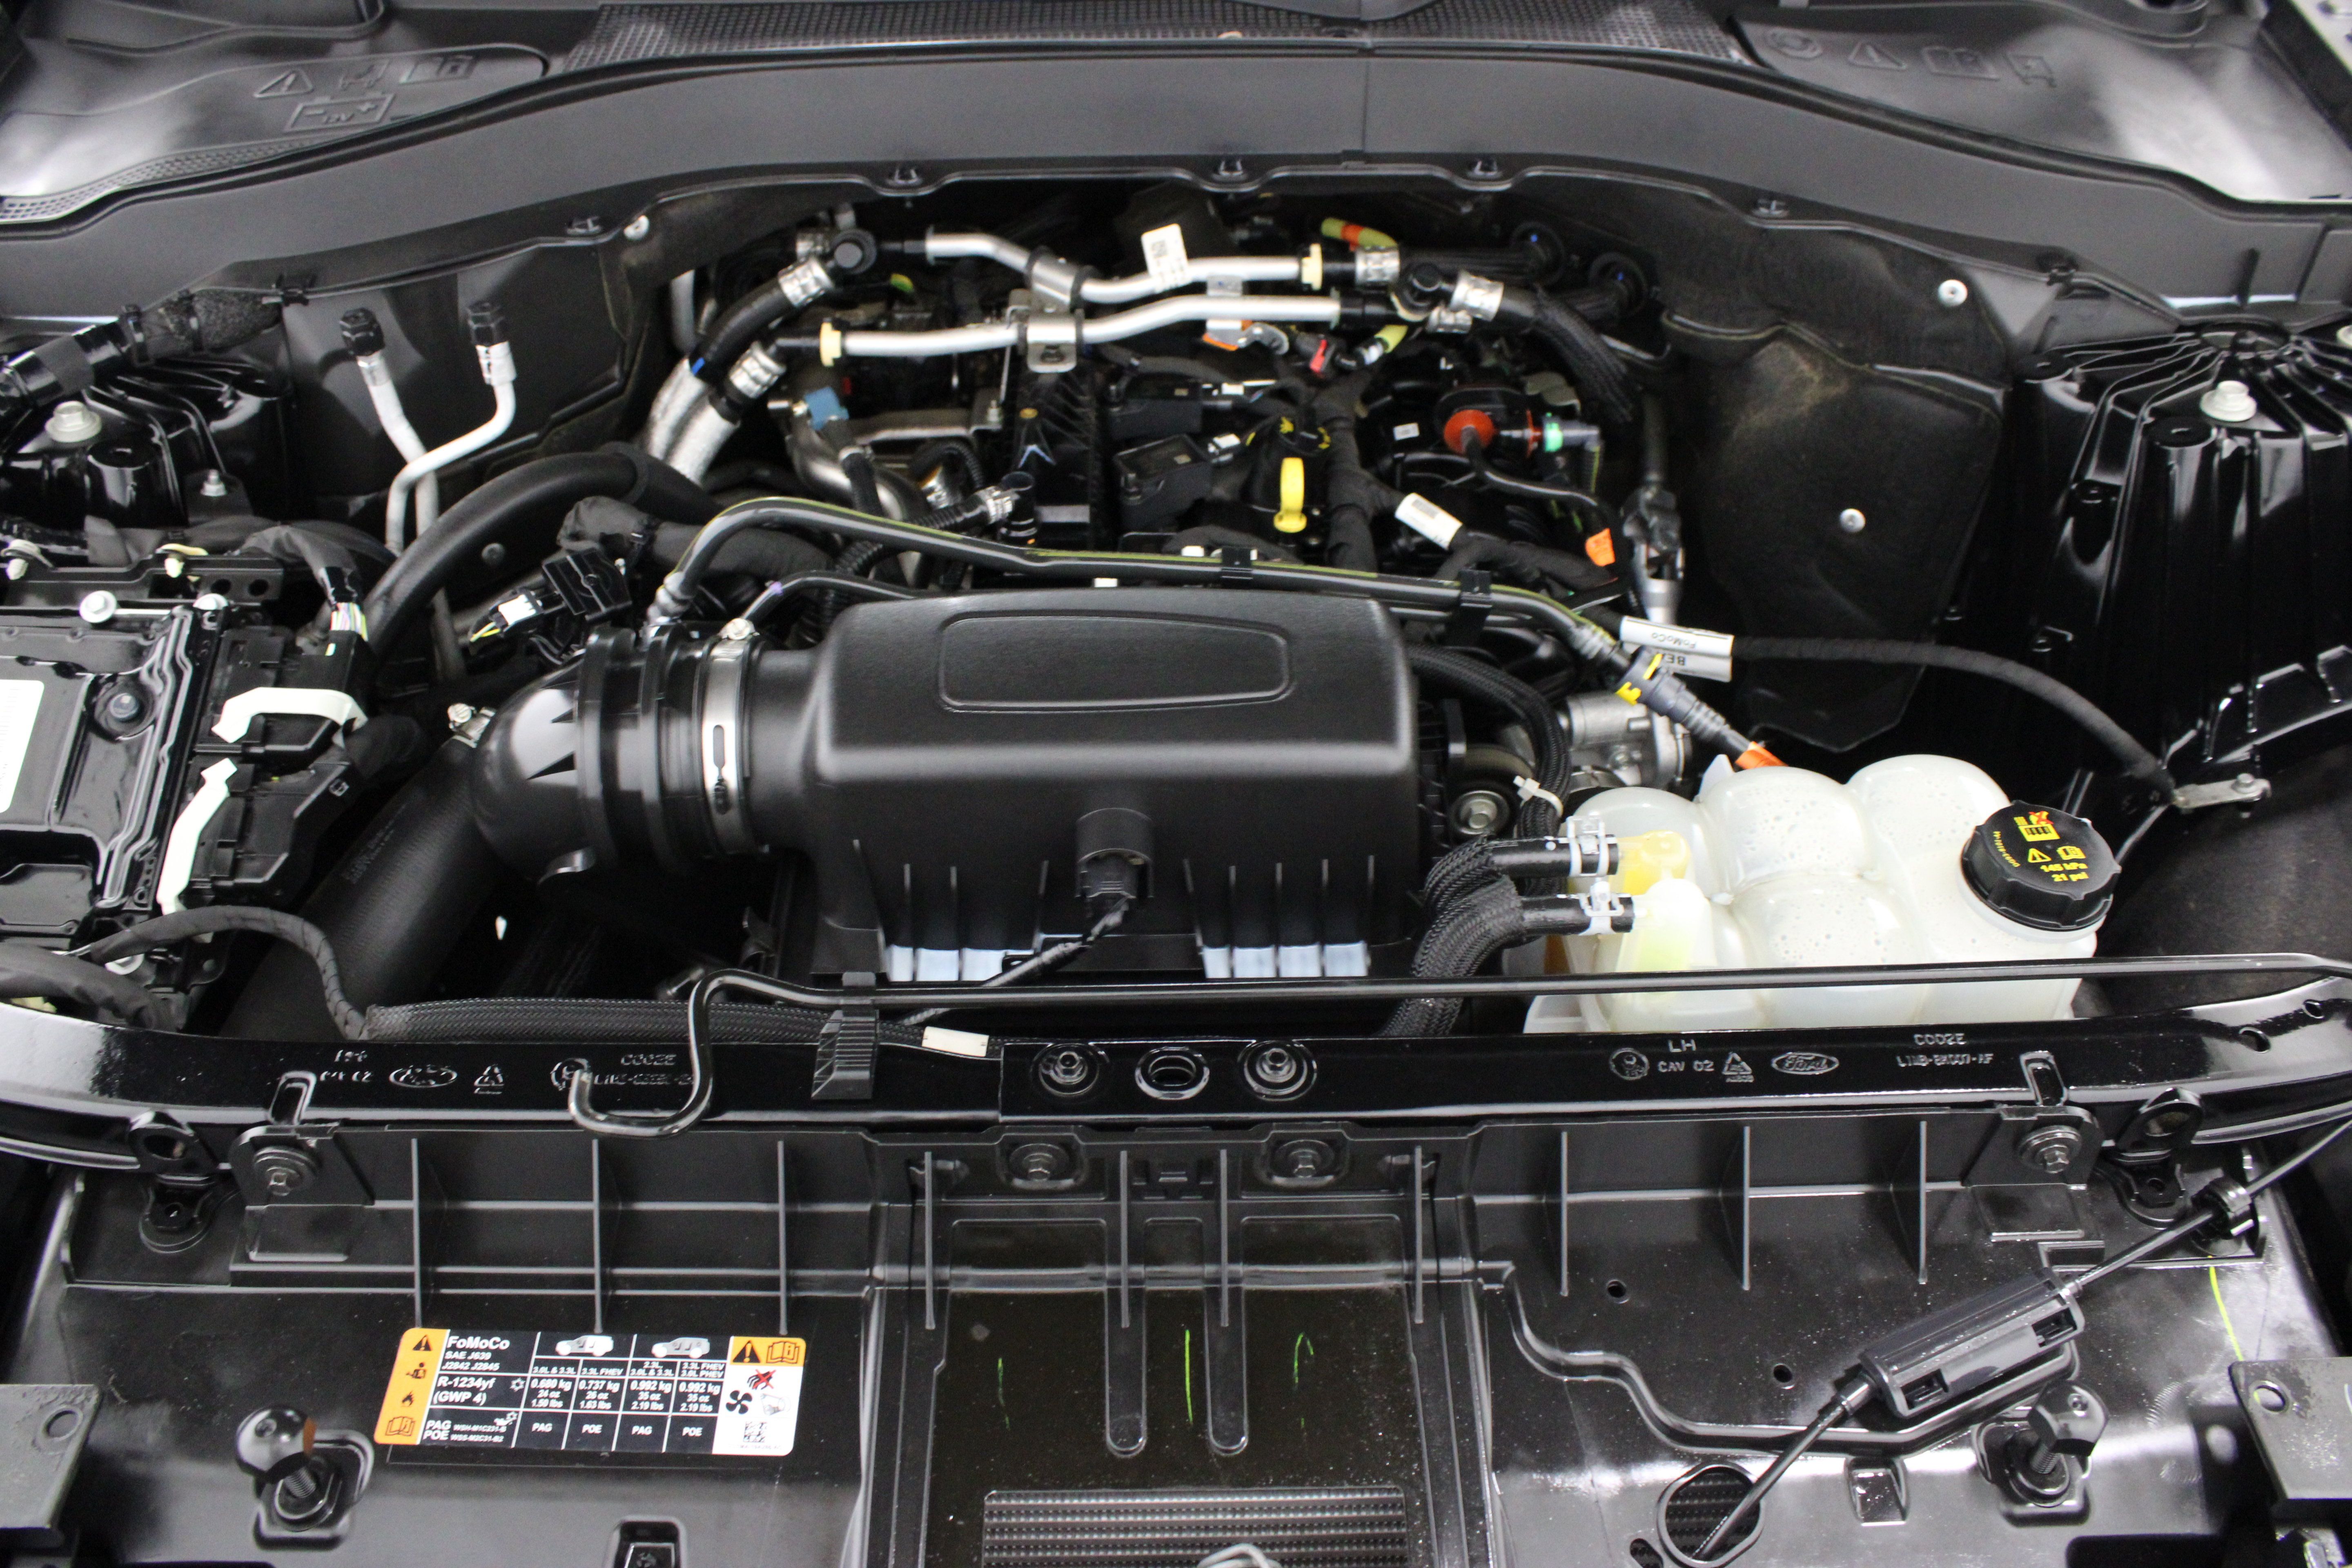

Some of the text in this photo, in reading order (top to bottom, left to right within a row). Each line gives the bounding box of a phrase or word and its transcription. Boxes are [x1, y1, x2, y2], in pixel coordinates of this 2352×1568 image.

[1651, 632, 1697, 648] FoMoCo
[1662, 654, 1686, 666] BE
[2040, 862, 2088, 872] 145 kPa
[2051, 872, 2089, 882] 21 psi
[1668, 1039, 1697, 1053] LH
[1658, 1061, 1685, 1072] CAV
[1782, 1053, 1829, 1072] Ford
[446, 1335, 510, 1350] FoMoCo
[444, 1351, 492, 1360] SAE J639
[441, 1361, 500, 1371] J2842 J2845
[700, 1363, 725, 1371] FHEV
[599, 1368, 624, 1376] FHEV
[437, 1376, 497, 1392] R-1234yf
[530, 1378, 572, 1392] 0.680 kg
[579, 1379, 620, 1393] 0.737 kg
[630, 1380, 673, 1394] 0.992 kg
[679, 1382, 721, 1396] 0.992 kg
[433, 1390, 487, 1406] (GWP 4)
[537, 1389, 549, 1398] 24
[585, 1390, 597, 1400] 26
[637, 1391, 650, 1401] 35
[686, 1393, 710, 1403] 35 oz
[531, 1398, 564, 1408] 1.50 lbs
[579, 1400, 612, 1410] 1.63 lbs
[630, 1401, 664, 1411] 2.19 lbs
[679, 1403, 713, 1413] 2.19 lbs
[425, 1419, 452, 1430] PAG
[531, 1422, 553, 1432] PAG
[581, 1424, 603, 1434] POE
[631, 1425, 653, 1435] PAG
[682, 1426, 703, 1437] POE
[422, 1430, 450, 1441] POE
